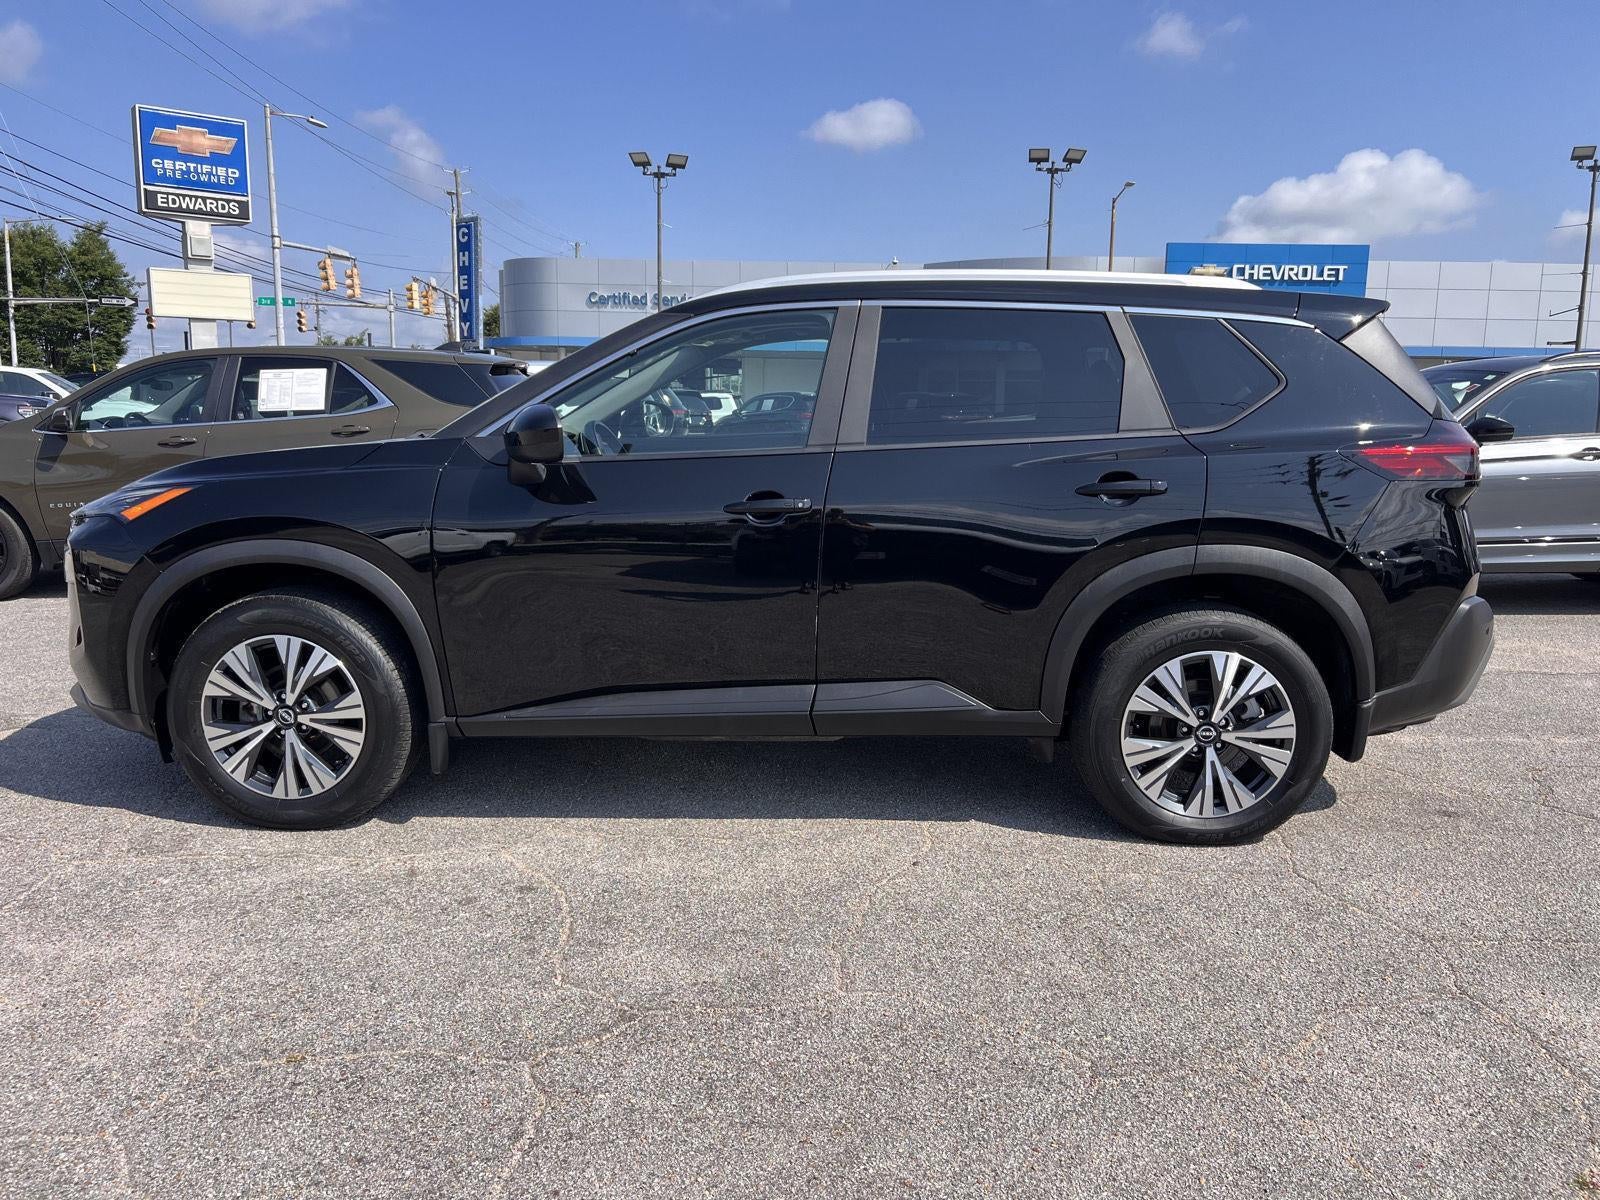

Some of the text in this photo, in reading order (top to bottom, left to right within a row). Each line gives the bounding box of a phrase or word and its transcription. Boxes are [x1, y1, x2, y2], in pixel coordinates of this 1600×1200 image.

[151, 158, 240, 178] CERTIFIED
[157, 168, 235, 185] PRE-OWNED
[157, 193, 240, 215] EDWARDS
[1231, 263, 1348, 281] CHEVROLET
[458, 227, 471, 337] CHEVY
[588, 290, 648, 306] Certified
